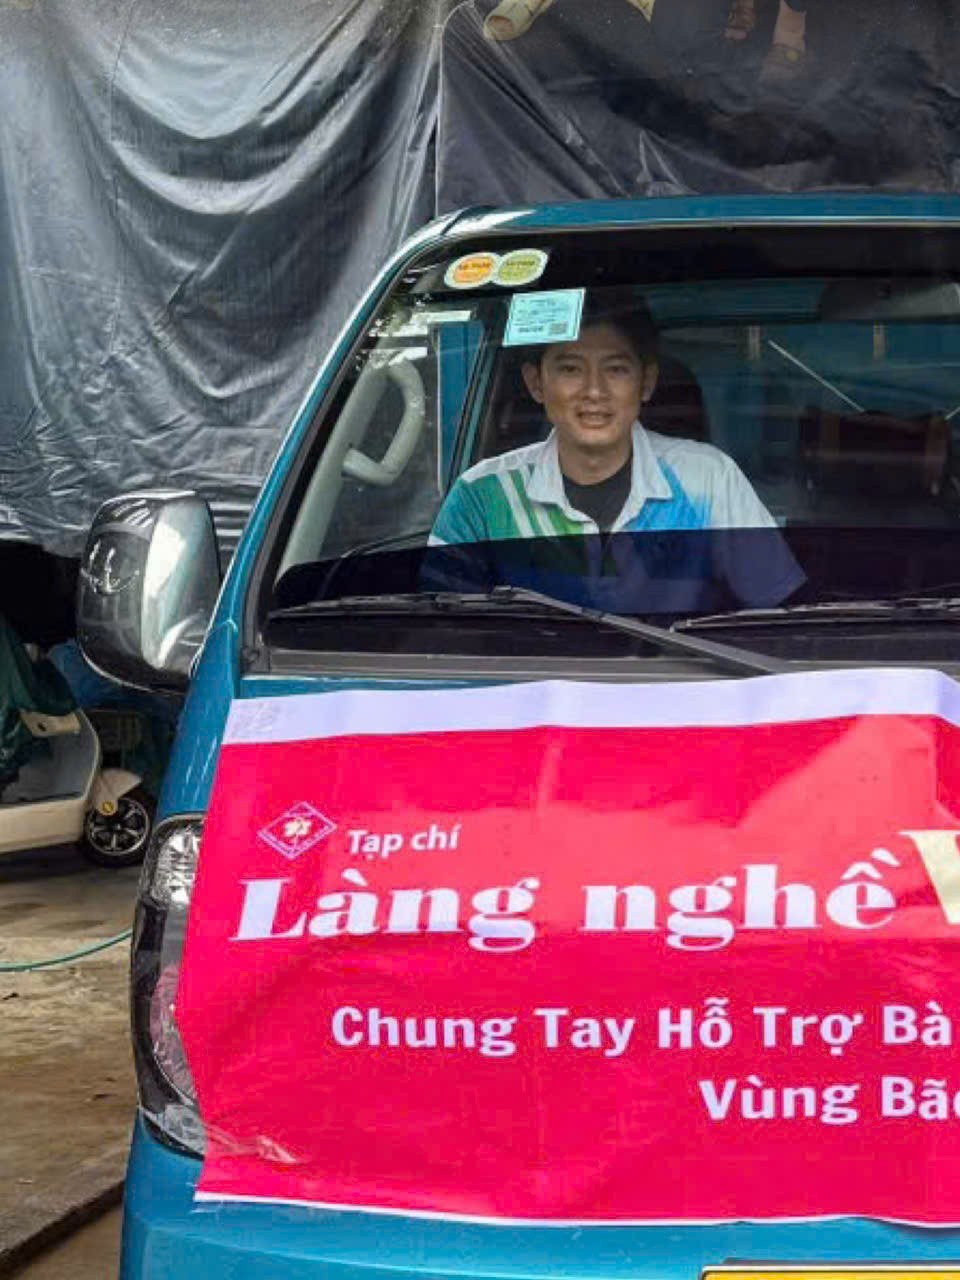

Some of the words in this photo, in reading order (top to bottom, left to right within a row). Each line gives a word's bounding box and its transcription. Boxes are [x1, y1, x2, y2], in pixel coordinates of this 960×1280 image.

[347, 829, 403, 859] Tạp
[411, 822, 461, 850] chí
[229, 868, 540, 952] Làng
[579, 848, 900, 951] nghề
[331, 1006, 518, 1057] Chung
[535, 1007, 635, 1057] Tay
[657, 997, 733, 1048] Hỗ
[753, 1005, 863, 1055] Trợ
[881, 1001, 952, 1046] Bà
[700, 1079, 859, 1125] Vùng
